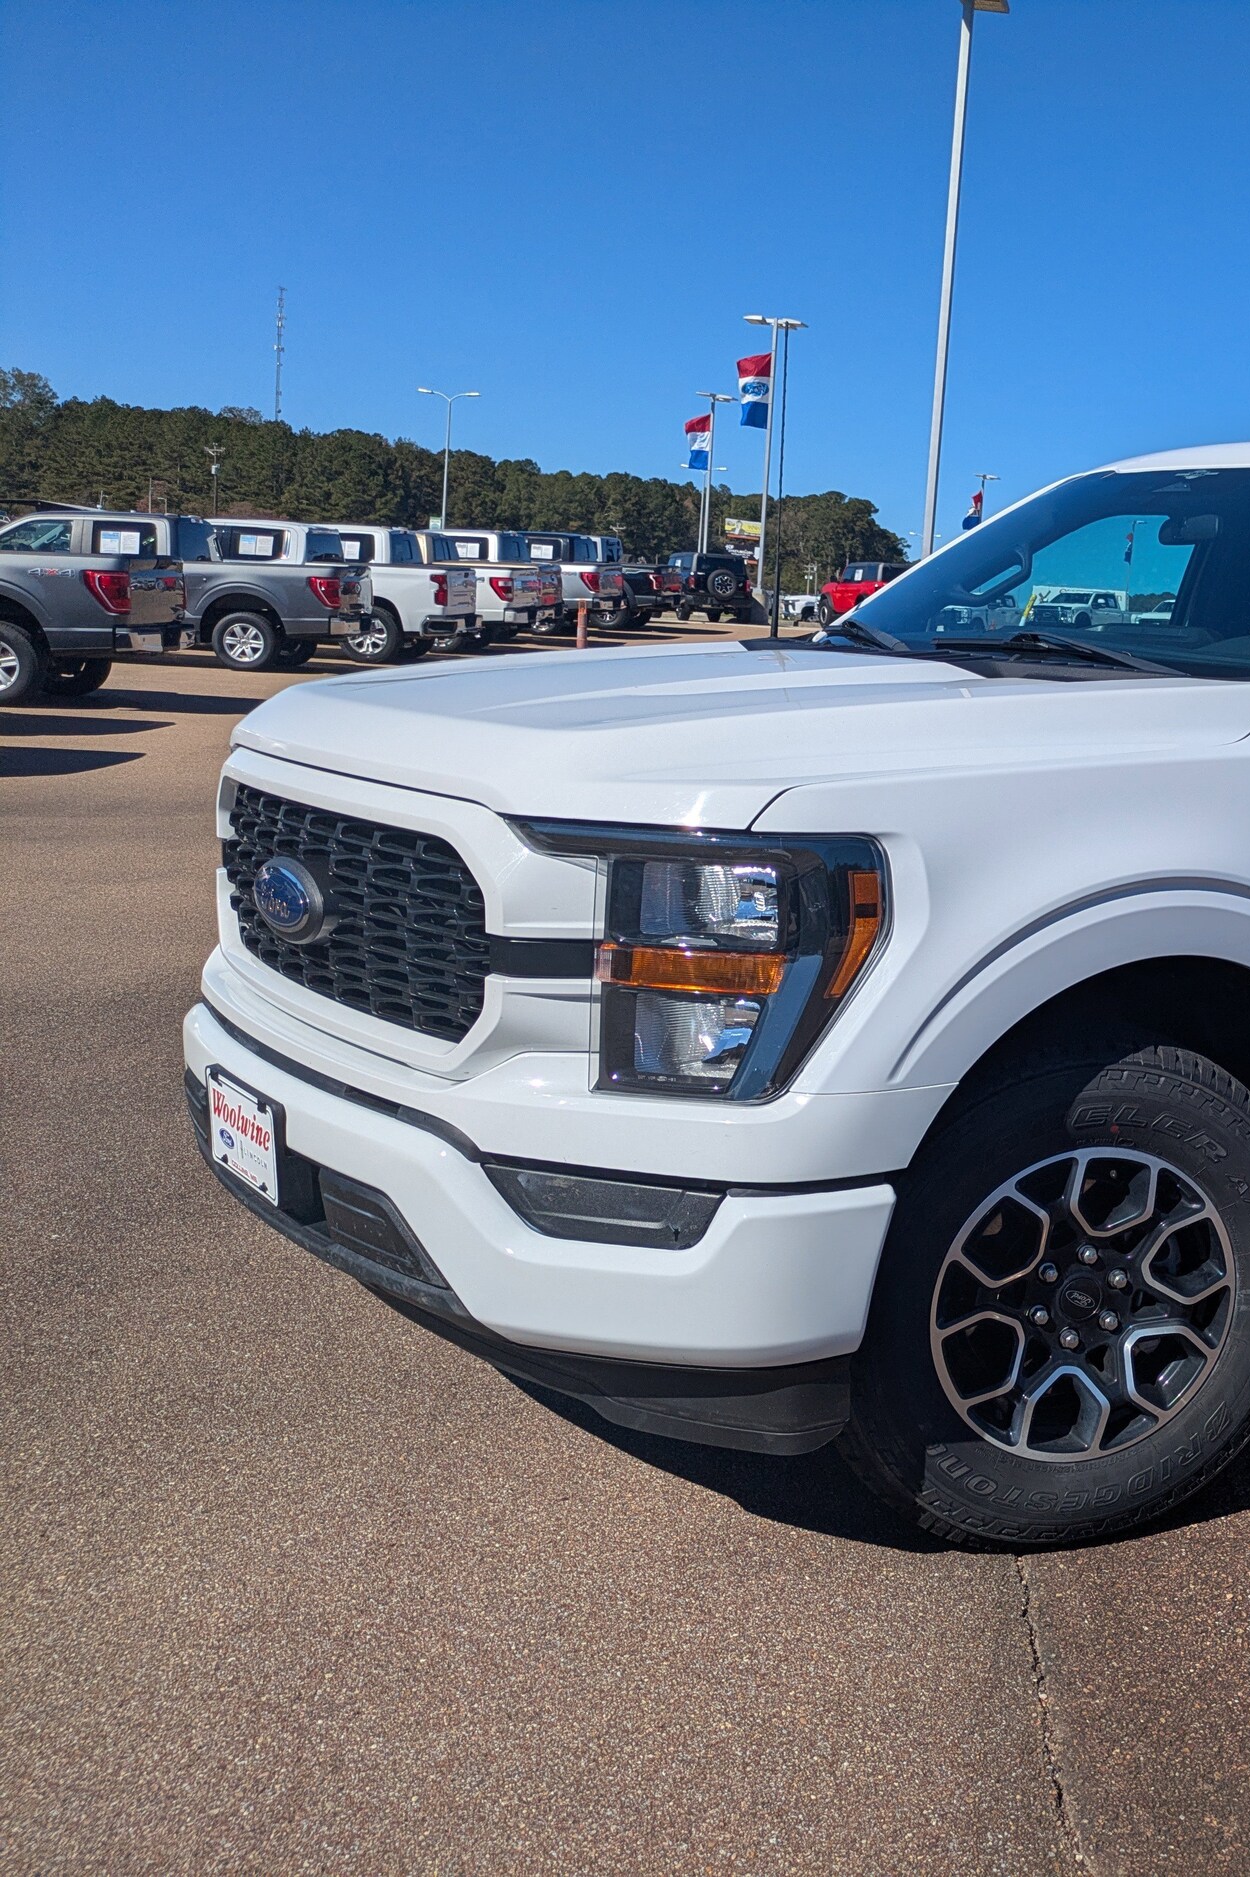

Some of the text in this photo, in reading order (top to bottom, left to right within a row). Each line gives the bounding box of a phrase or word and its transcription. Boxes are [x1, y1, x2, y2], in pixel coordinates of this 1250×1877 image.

[212, 1087, 271, 1152] Woolwine
[1070, 1102, 1228, 1164] ELER
[243, 1147, 268, 1170] LINCOLN
[1070, 1292, 1092, 1306] Ford
